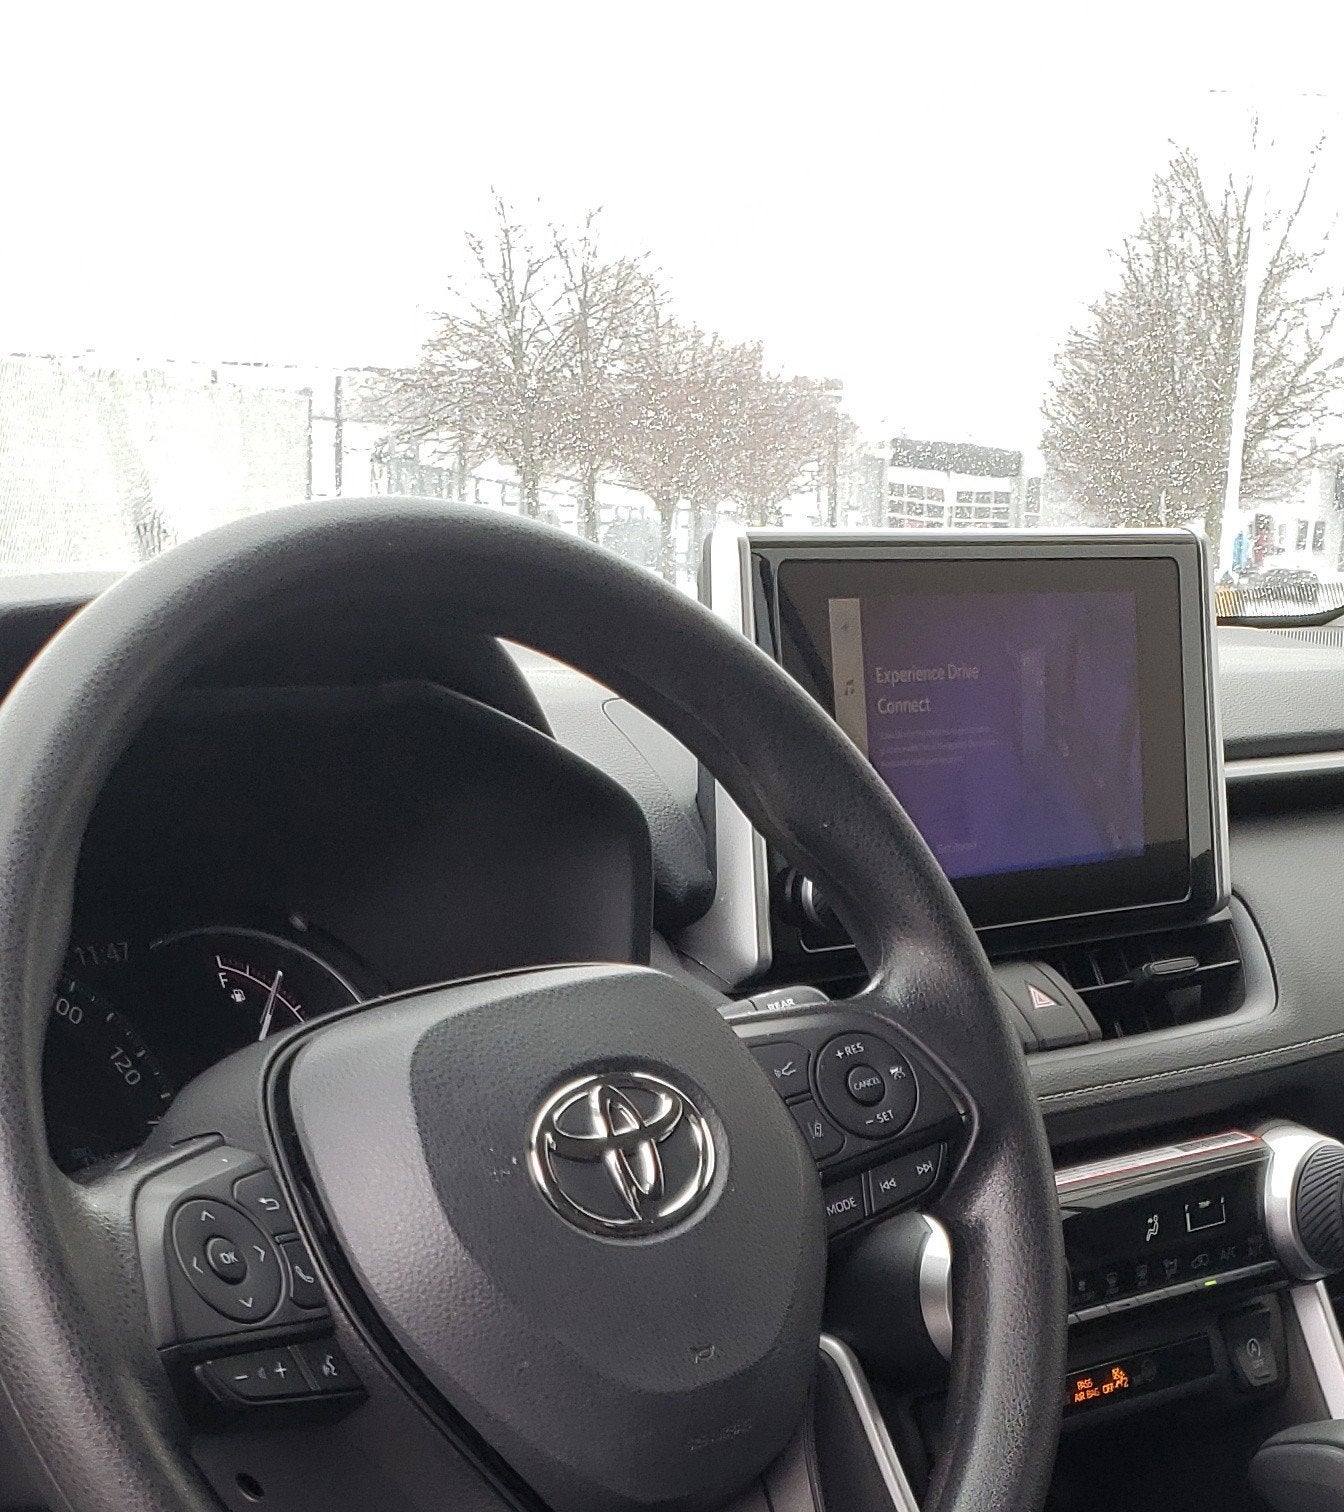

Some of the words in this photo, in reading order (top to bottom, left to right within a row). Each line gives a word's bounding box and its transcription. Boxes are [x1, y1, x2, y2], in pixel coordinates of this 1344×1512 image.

[874, 663, 945, 684] Experience
[946, 662, 980, 681] Drive
[877, 696, 932, 715] Connect
[73, 940, 129, 966] 11:47
[216, 971, 230, 990] F
[55, 996, 84, 1026] 00
[767, 998, 795, 1012] REAR
[108, 1045, 142, 1087] 120
[853, 1077, 882, 1091] CANCEL
[826, 1196, 858, 1217] MODE
[219, 1251, 239, 1265] OK
